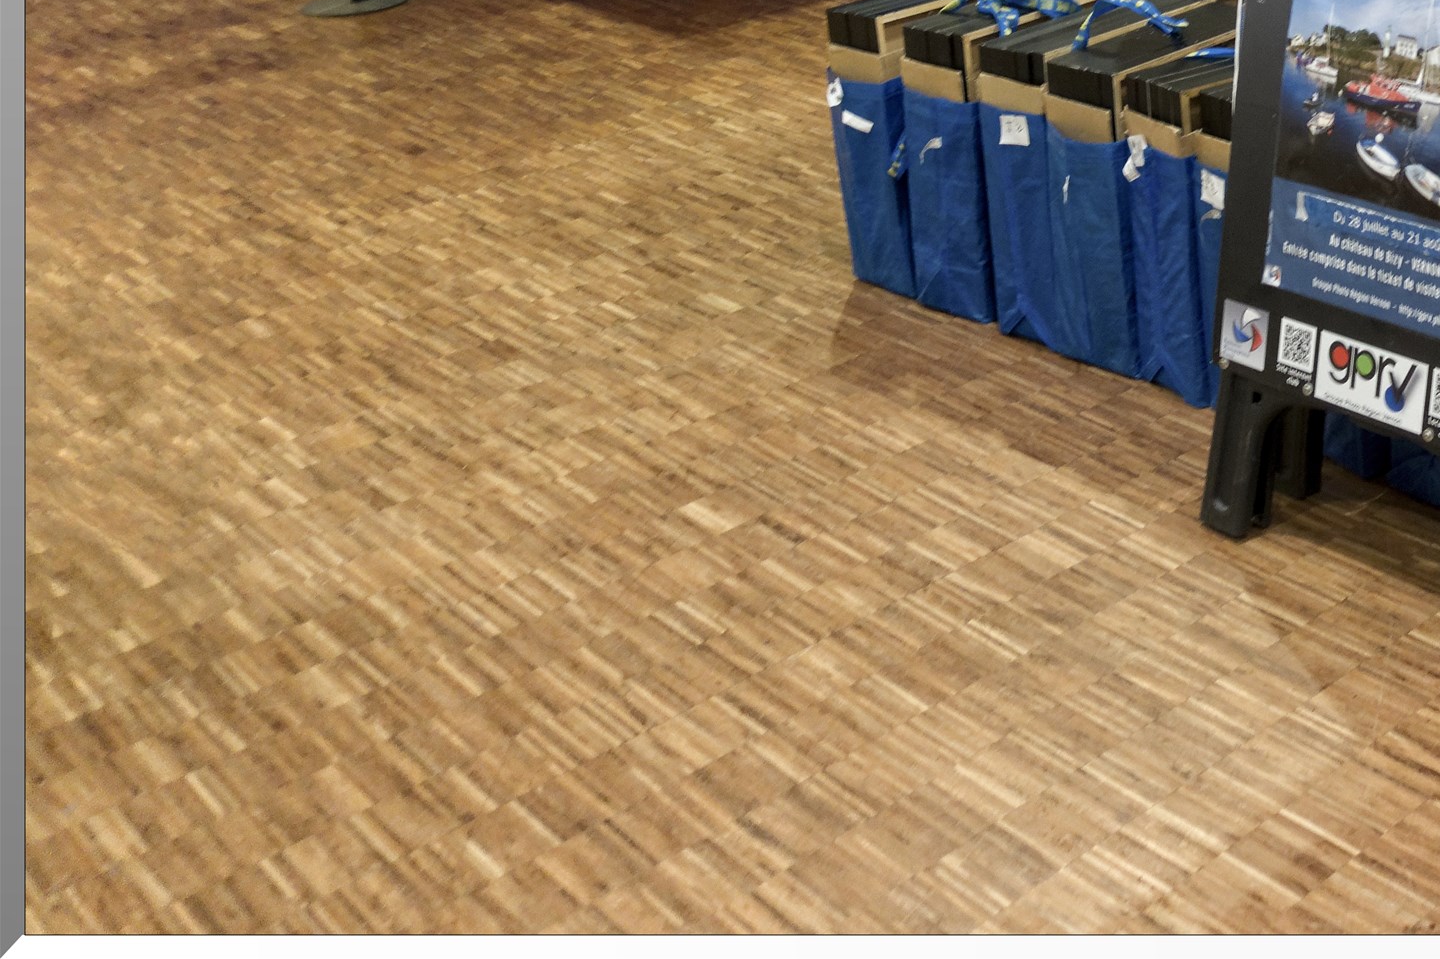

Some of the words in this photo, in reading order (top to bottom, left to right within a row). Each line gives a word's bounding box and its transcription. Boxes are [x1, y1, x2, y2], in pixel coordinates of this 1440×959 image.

[1390, 228, 1405, 241] au
[1406, 230, 1420, 246] 21
[1373, 246, 1385, 261] de
[1308, 250, 1347, 269] comprise
[1346, 260, 1367, 277] dans
[1377, 268, 1403, 287] ticket
[1403, 276, 1415, 291] de
[1415, 281, 1440, 299] visite
